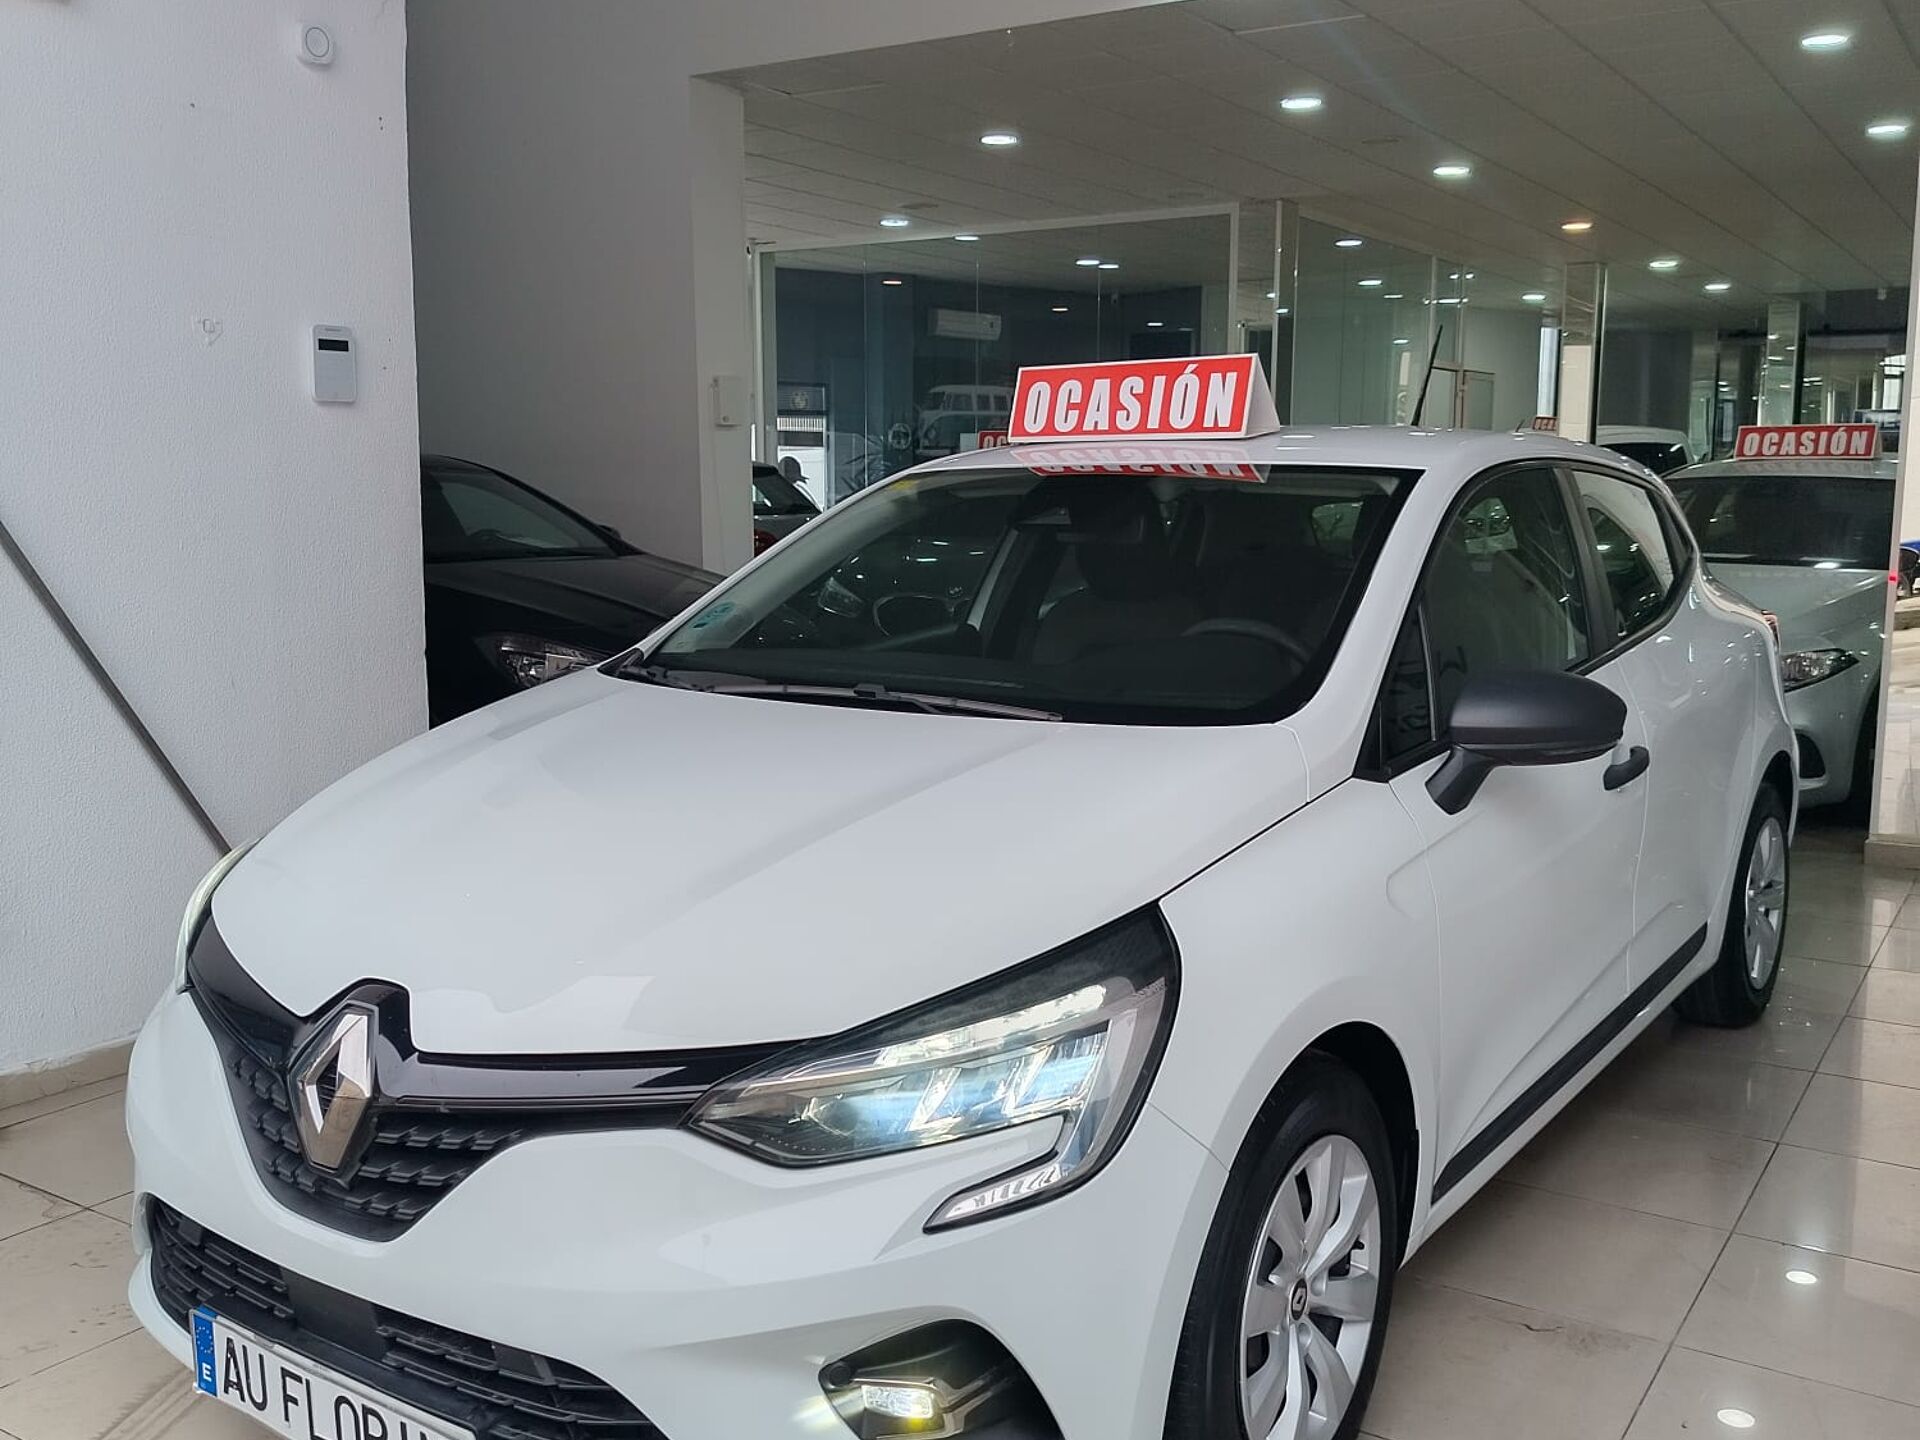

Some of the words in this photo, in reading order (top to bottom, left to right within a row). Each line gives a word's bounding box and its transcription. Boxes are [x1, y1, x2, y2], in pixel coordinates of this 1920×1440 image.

[1023, 364, 1238, 433] OCASIÓN
[1743, 428, 1868, 456] OCASIÓN
[202, 1362, 212, 1382] E
[223, 1336, 268, 1412] AU
